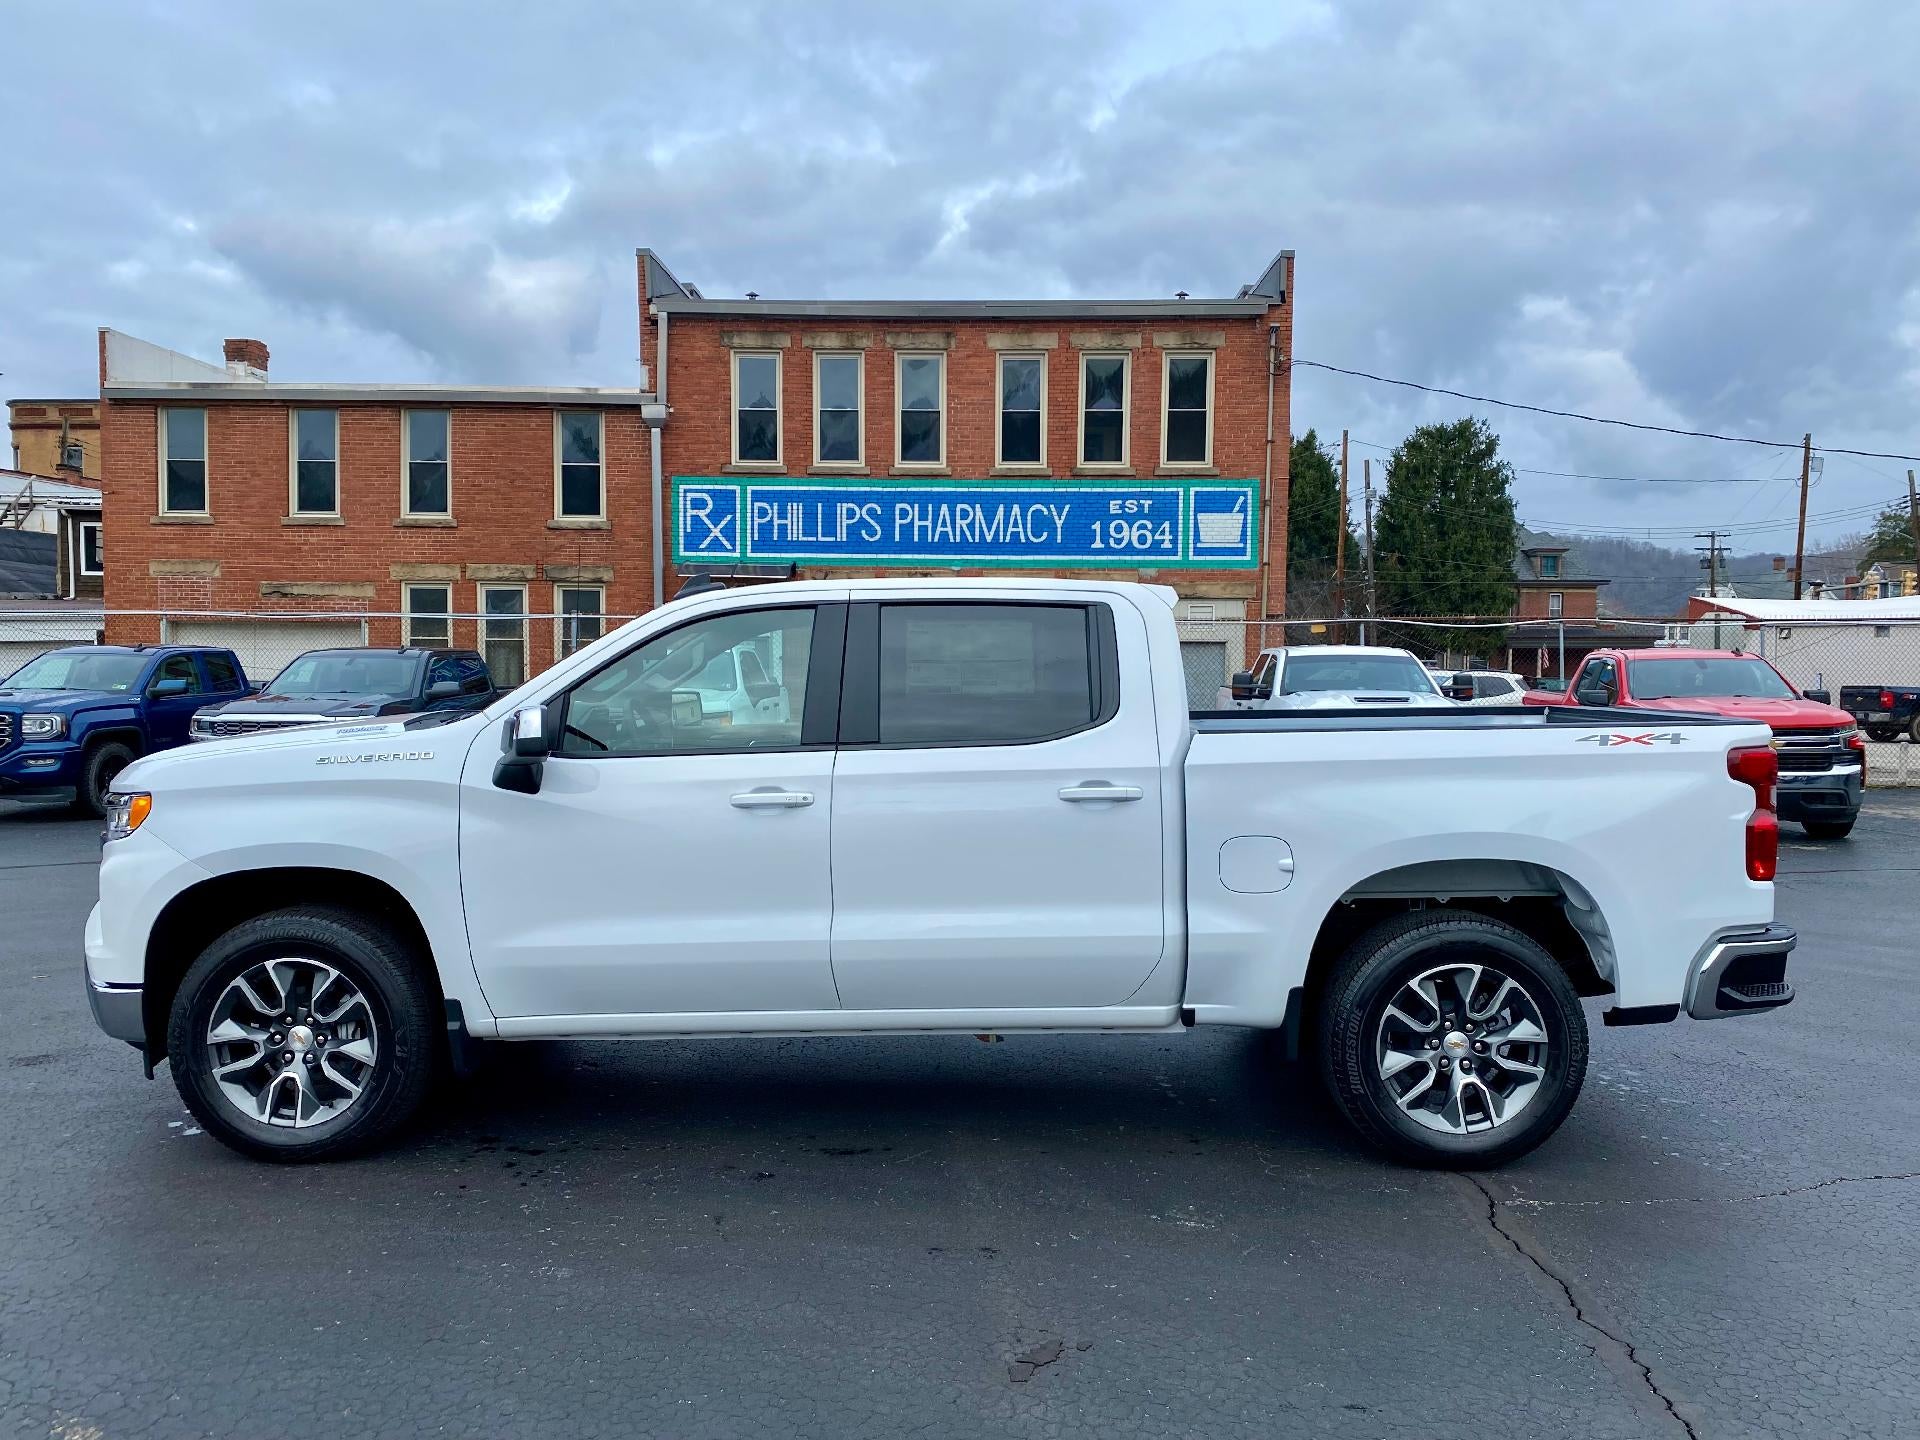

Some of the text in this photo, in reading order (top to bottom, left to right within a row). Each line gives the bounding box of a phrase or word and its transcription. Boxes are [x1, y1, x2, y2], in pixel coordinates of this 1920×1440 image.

[1109, 500, 1153, 514] EST
[753, 502, 1071, 543] PHILLIPS PHARMACY
[1091, 519, 1173, 549] 1964
[316, 751, 435, 765] SILVERADO
[1346, 1007, 1365, 1095] BRIDGESTONE
